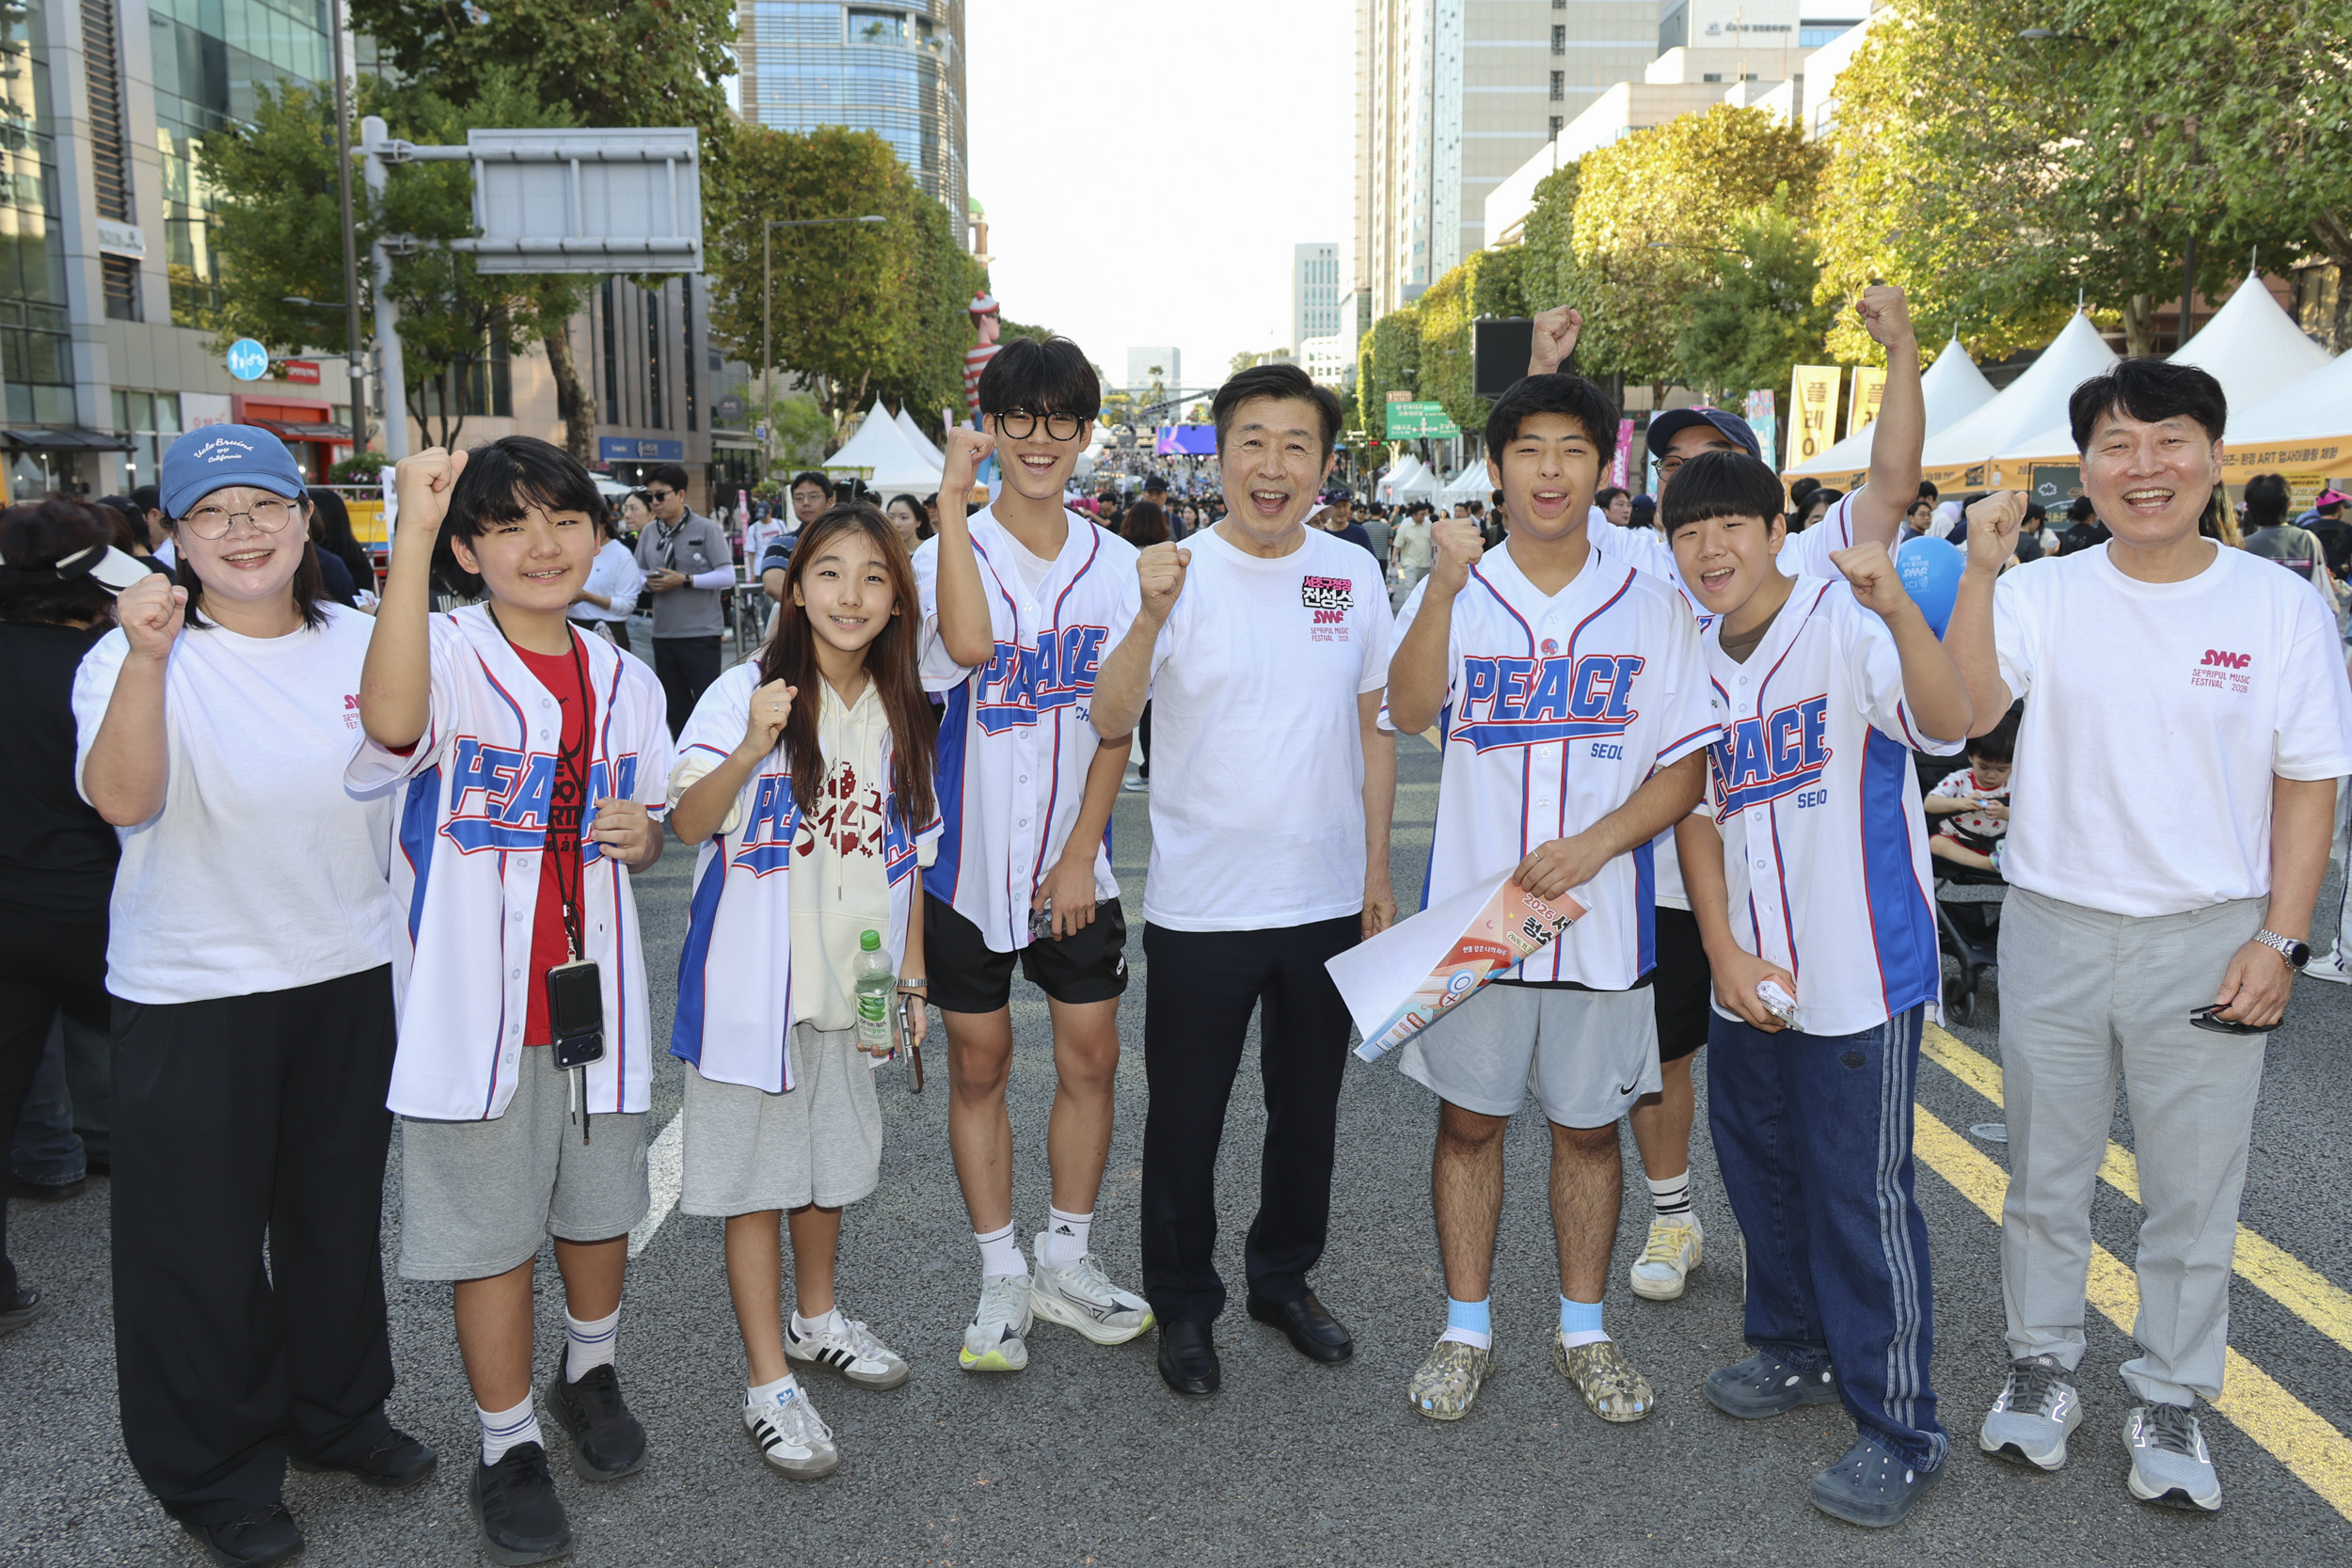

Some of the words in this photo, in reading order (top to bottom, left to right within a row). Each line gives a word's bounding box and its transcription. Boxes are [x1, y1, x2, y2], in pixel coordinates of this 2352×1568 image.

[2257, 451, 2277, 465] ART
[2279, 448, 2320, 463] 업사이클링
[1302, 576, 1352, 592] 서초구청장
[1302, 586, 1355, 611] 전성수
[1311, 634, 1334, 642] FESTIVAL
[2190, 677, 2224, 689] FESTIVAL
[2229, 673, 2251, 685] MUSIC
[1458, 655, 1645, 723] PEACE
[1522, 893, 1557, 922] 2026
